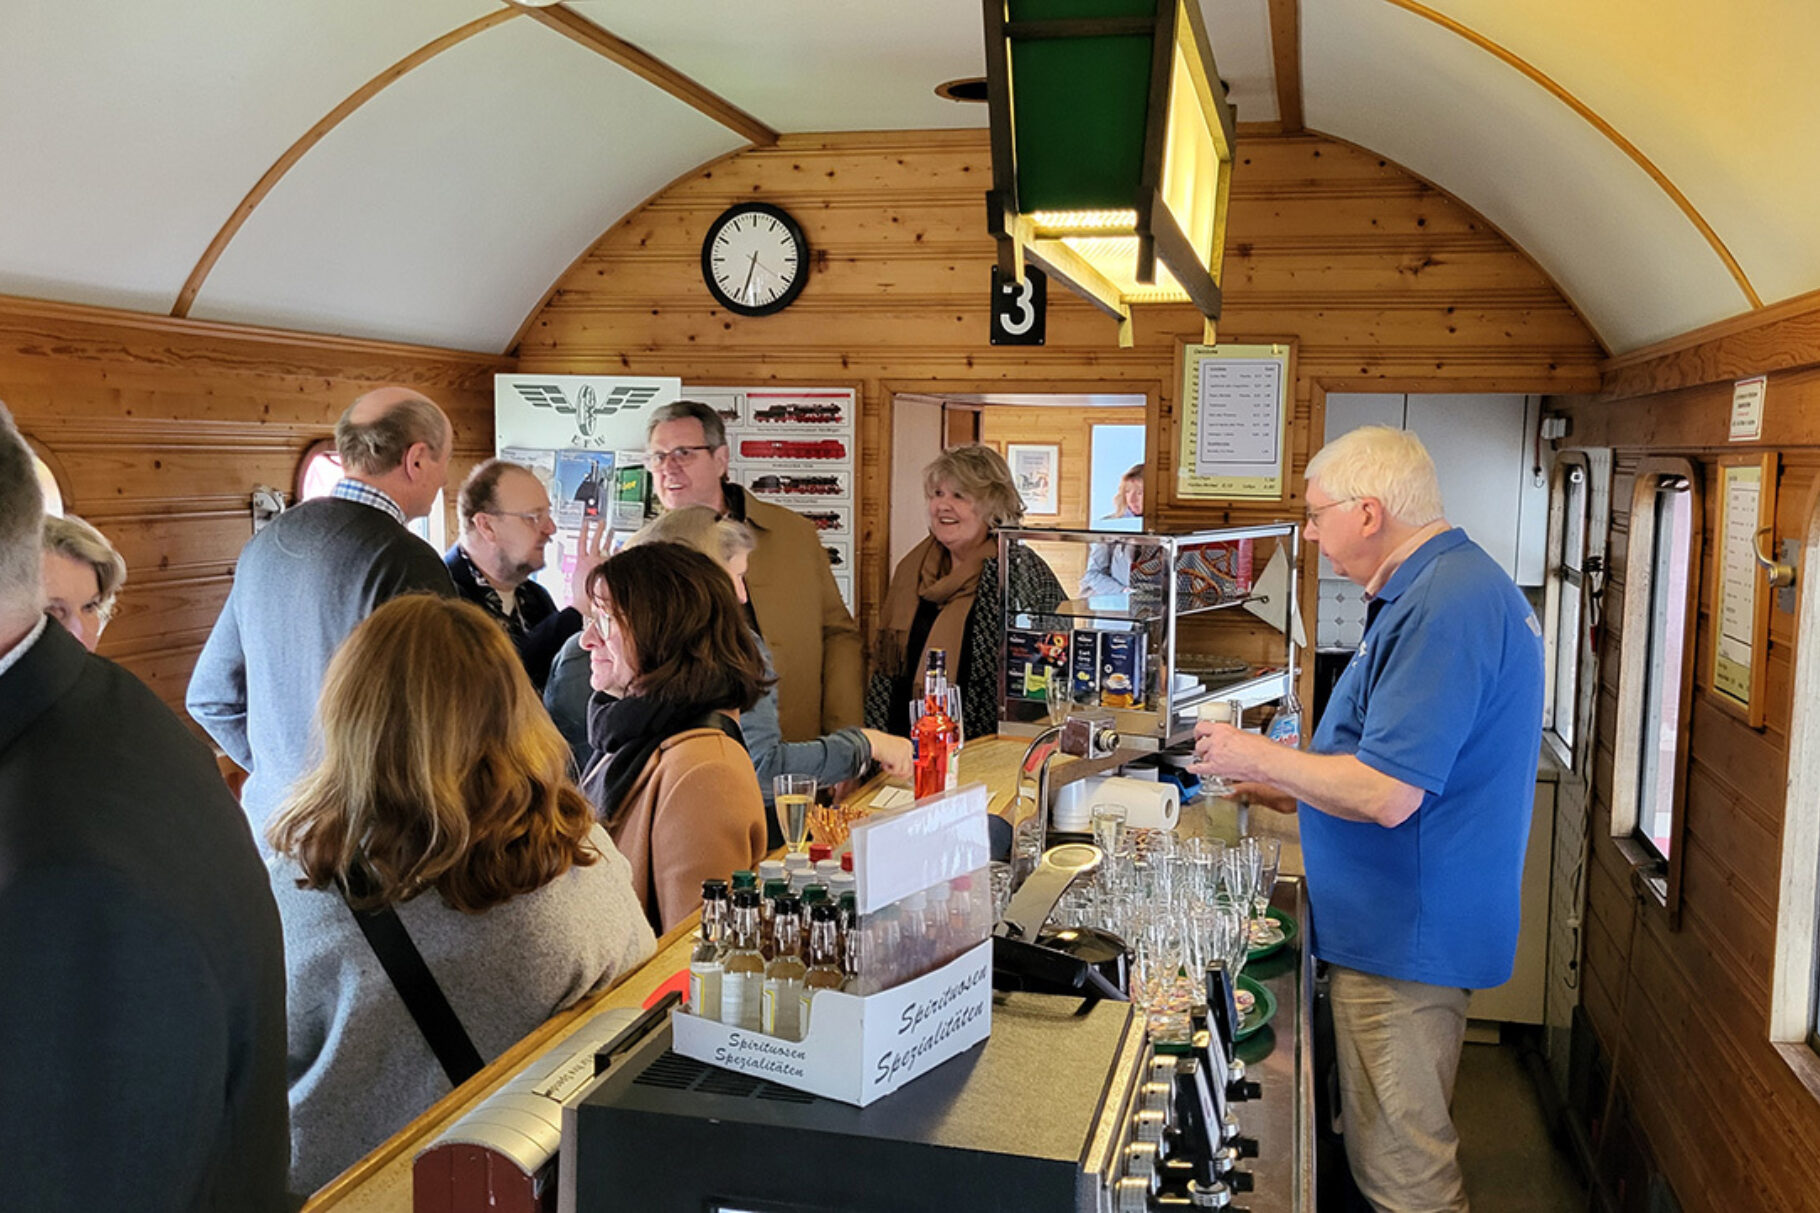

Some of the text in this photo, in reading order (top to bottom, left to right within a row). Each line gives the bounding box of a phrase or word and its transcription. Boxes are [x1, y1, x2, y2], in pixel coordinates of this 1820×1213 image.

[1000, 276, 1035, 335] 3
[898, 965, 987, 1035] Spirituosen
[715, 1047, 804, 1077] Spezialitäten
[728, 1033, 806, 1060] Spirituosen
[874, 1001, 984, 1085] Spezialitäten
